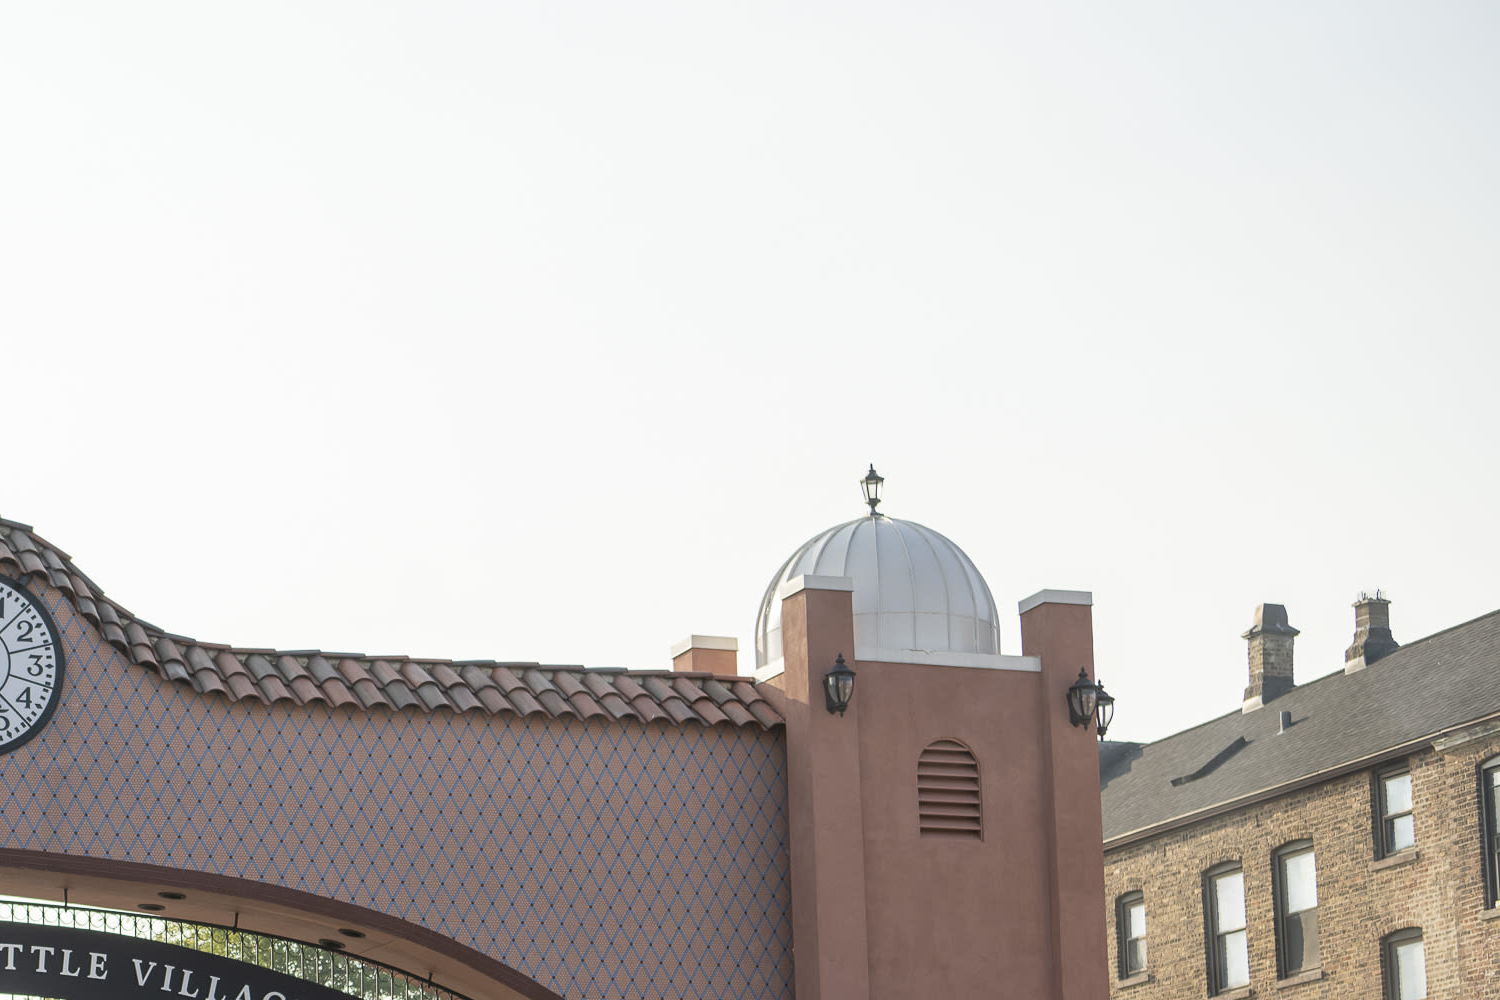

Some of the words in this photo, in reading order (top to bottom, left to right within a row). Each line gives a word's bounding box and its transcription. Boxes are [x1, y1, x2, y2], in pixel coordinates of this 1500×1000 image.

[16, 621, 33, 643] 2
[27, 654, 44, 676] 3
[16, 687, 32, 709] 4
